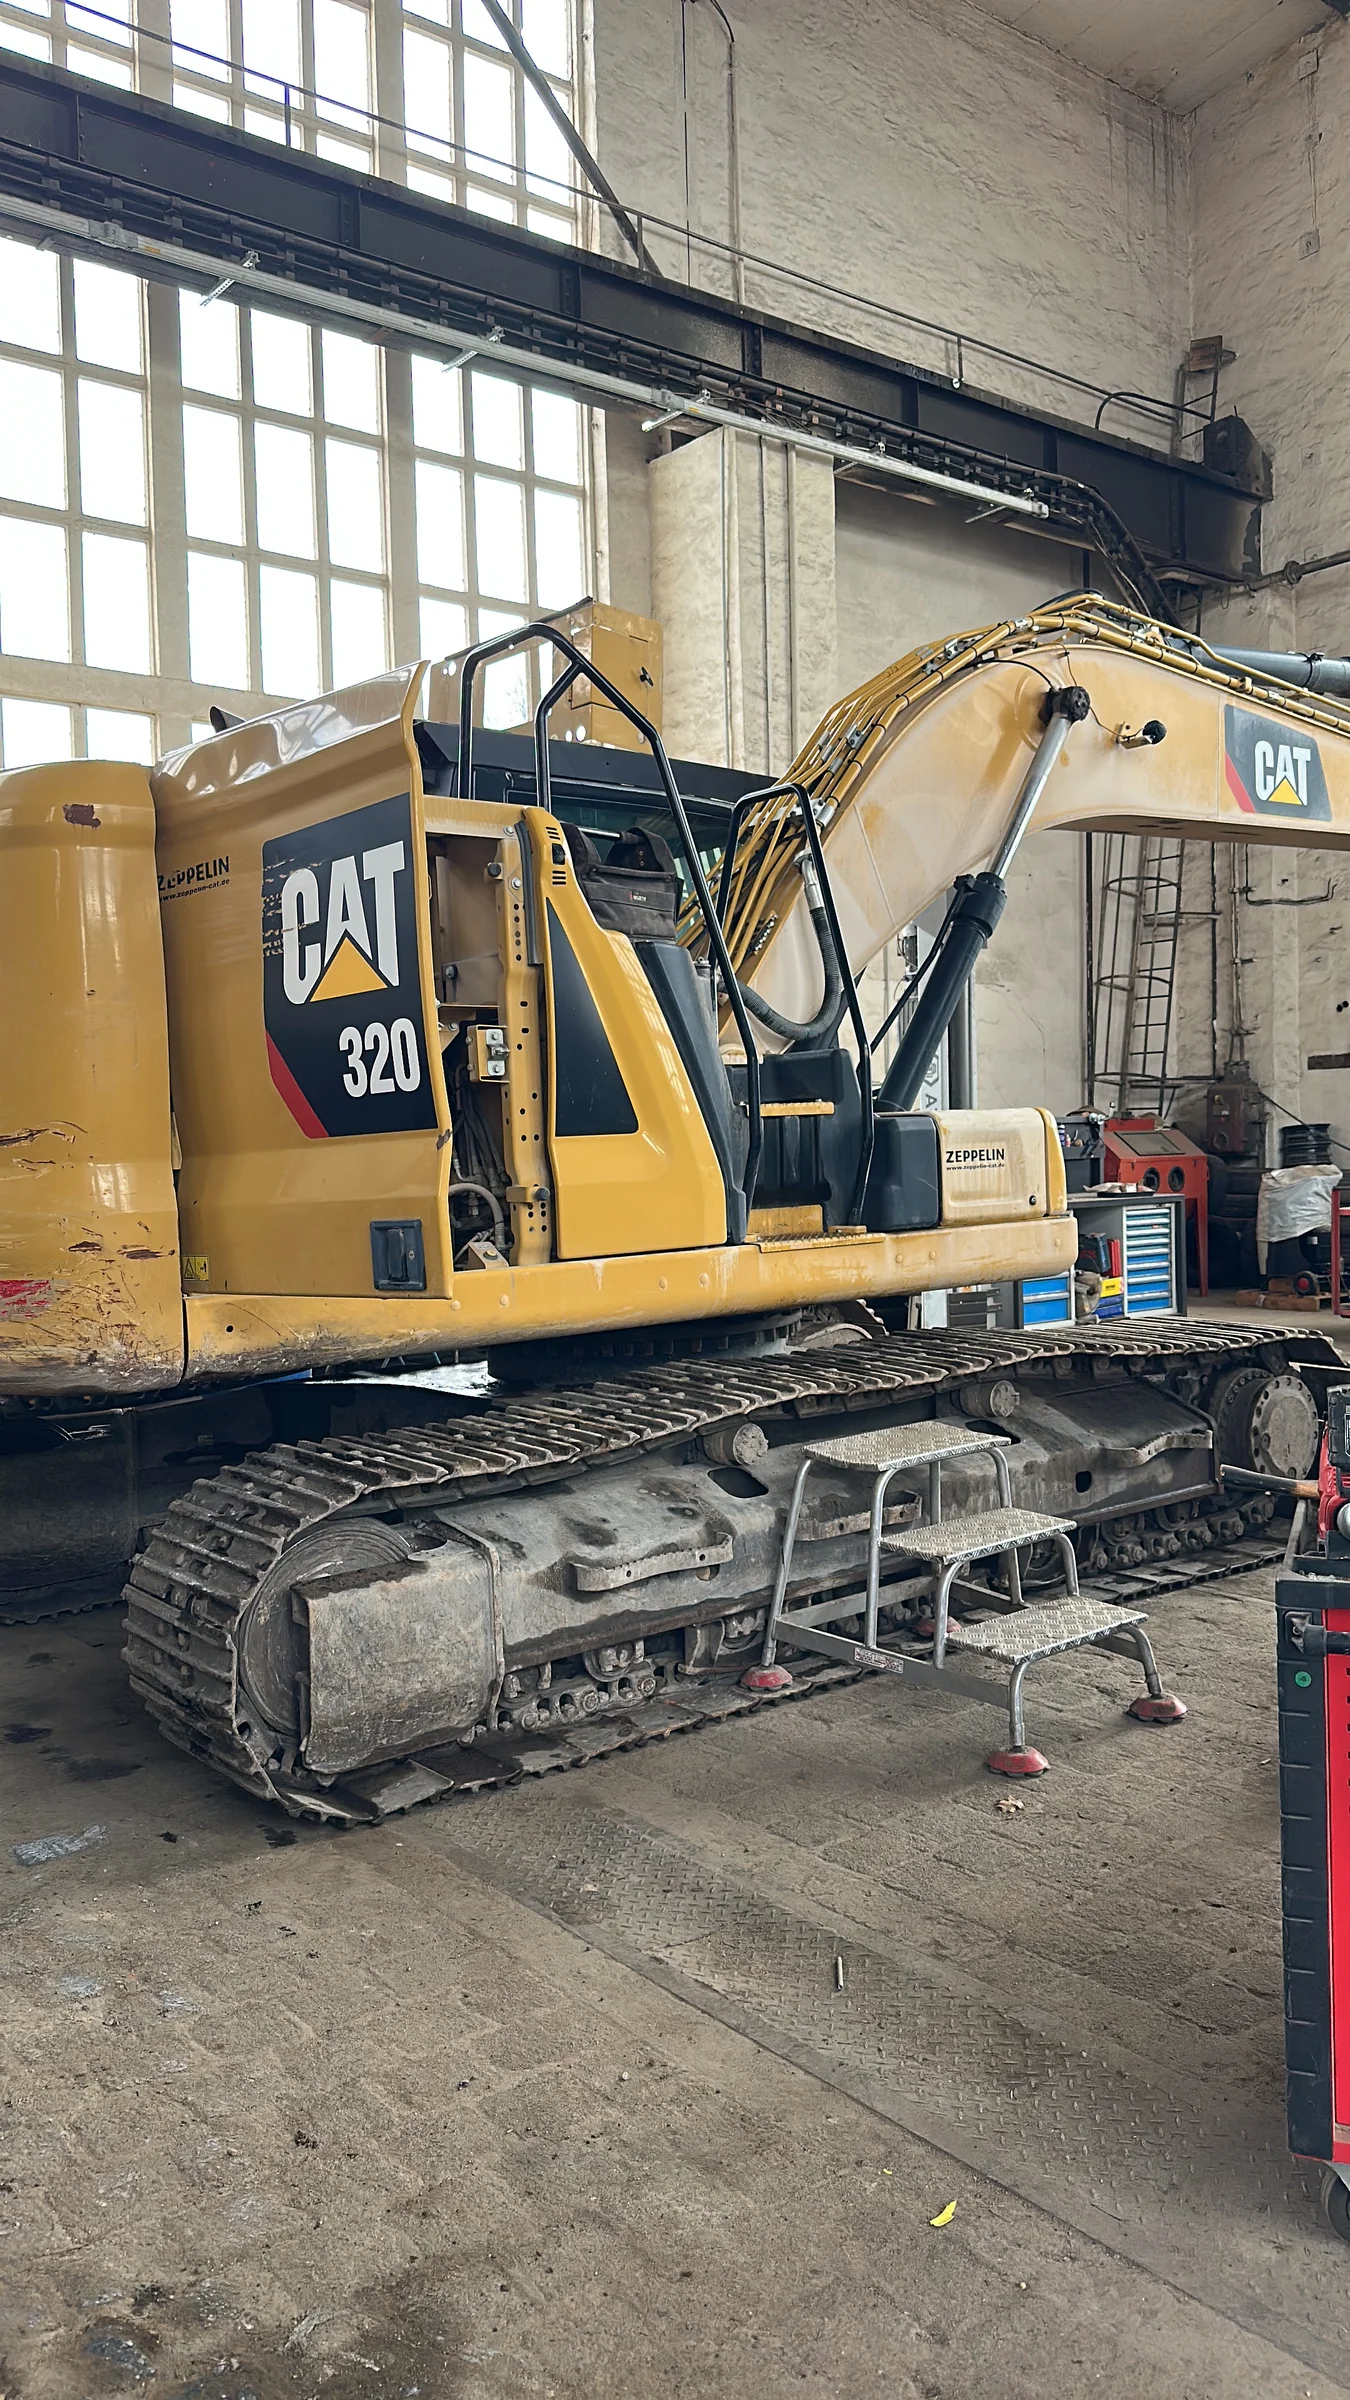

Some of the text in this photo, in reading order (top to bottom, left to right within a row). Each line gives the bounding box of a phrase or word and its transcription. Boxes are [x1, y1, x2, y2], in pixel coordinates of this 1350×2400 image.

[1254, 740, 1311, 806] CAT
[281, 840, 405, 1005] CAT
[339, 1017, 421, 1098] 320
[945, 1148, 1005, 1163] ZEPPELIN
[946, 1162, 1005, 1171] www.zeppelin-cat.de
